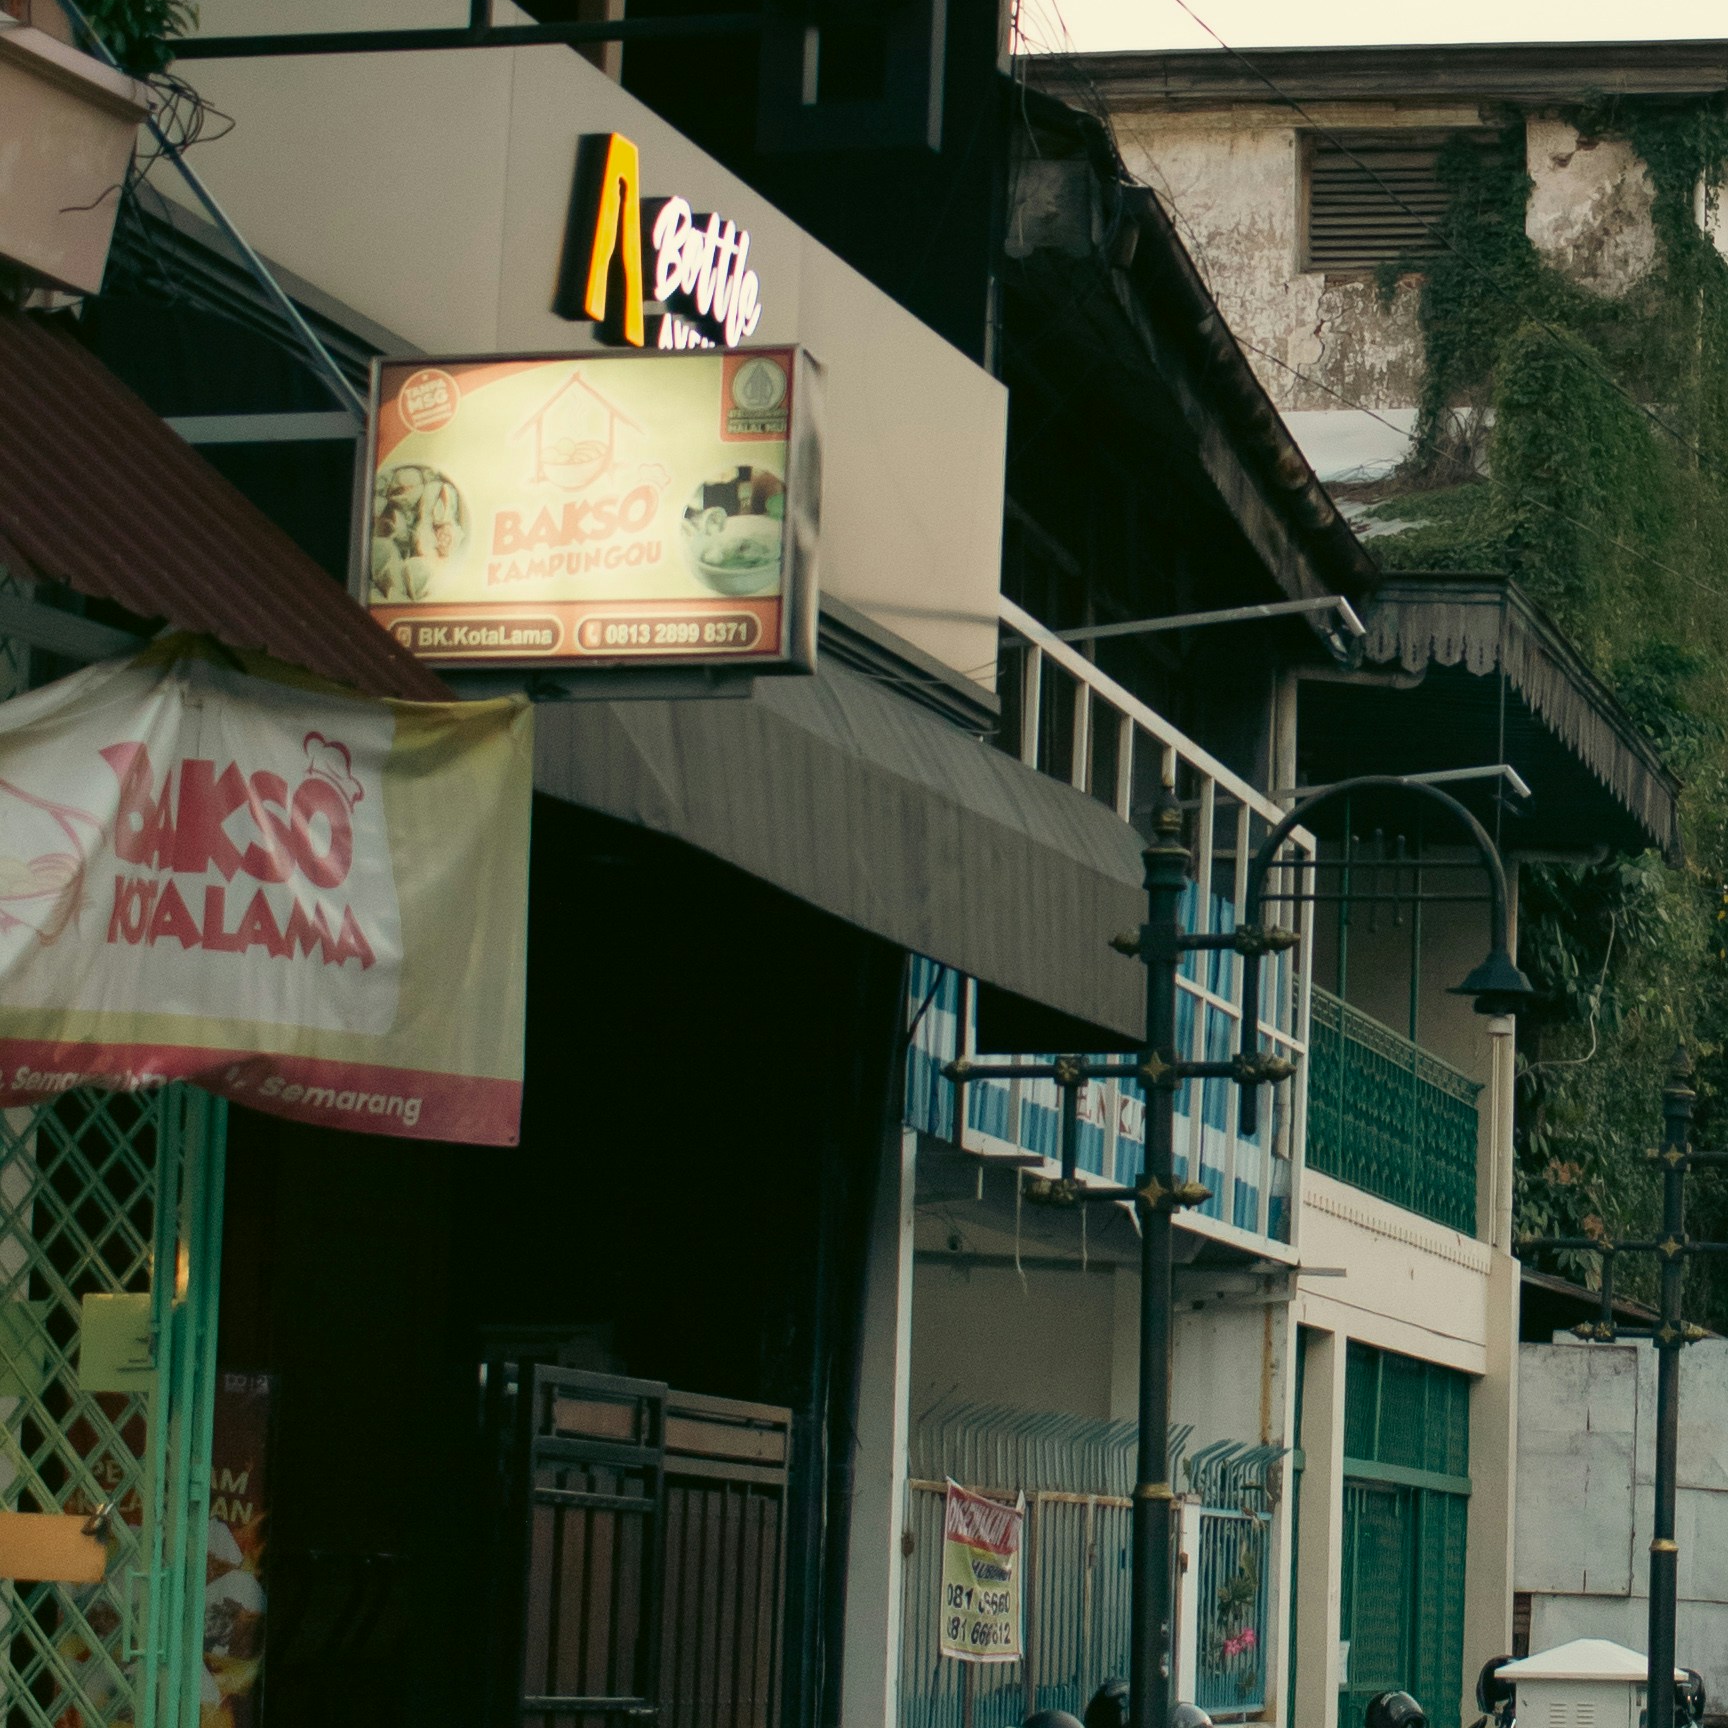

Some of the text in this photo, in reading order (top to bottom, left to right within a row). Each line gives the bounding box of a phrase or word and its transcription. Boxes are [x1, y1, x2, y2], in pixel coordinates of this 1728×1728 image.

[653, 195, 762, 348] Bottle
[407, 388, 449, 414] MSG
[492, 484, 659, 557] BAKSO
[419, 624, 553, 647] BK.KotaLama
[605, 621, 748, 645] 0813 2899 8371
[99, 741, 353, 889] BAKSO
[258, 1075, 423, 1128] Semarang
